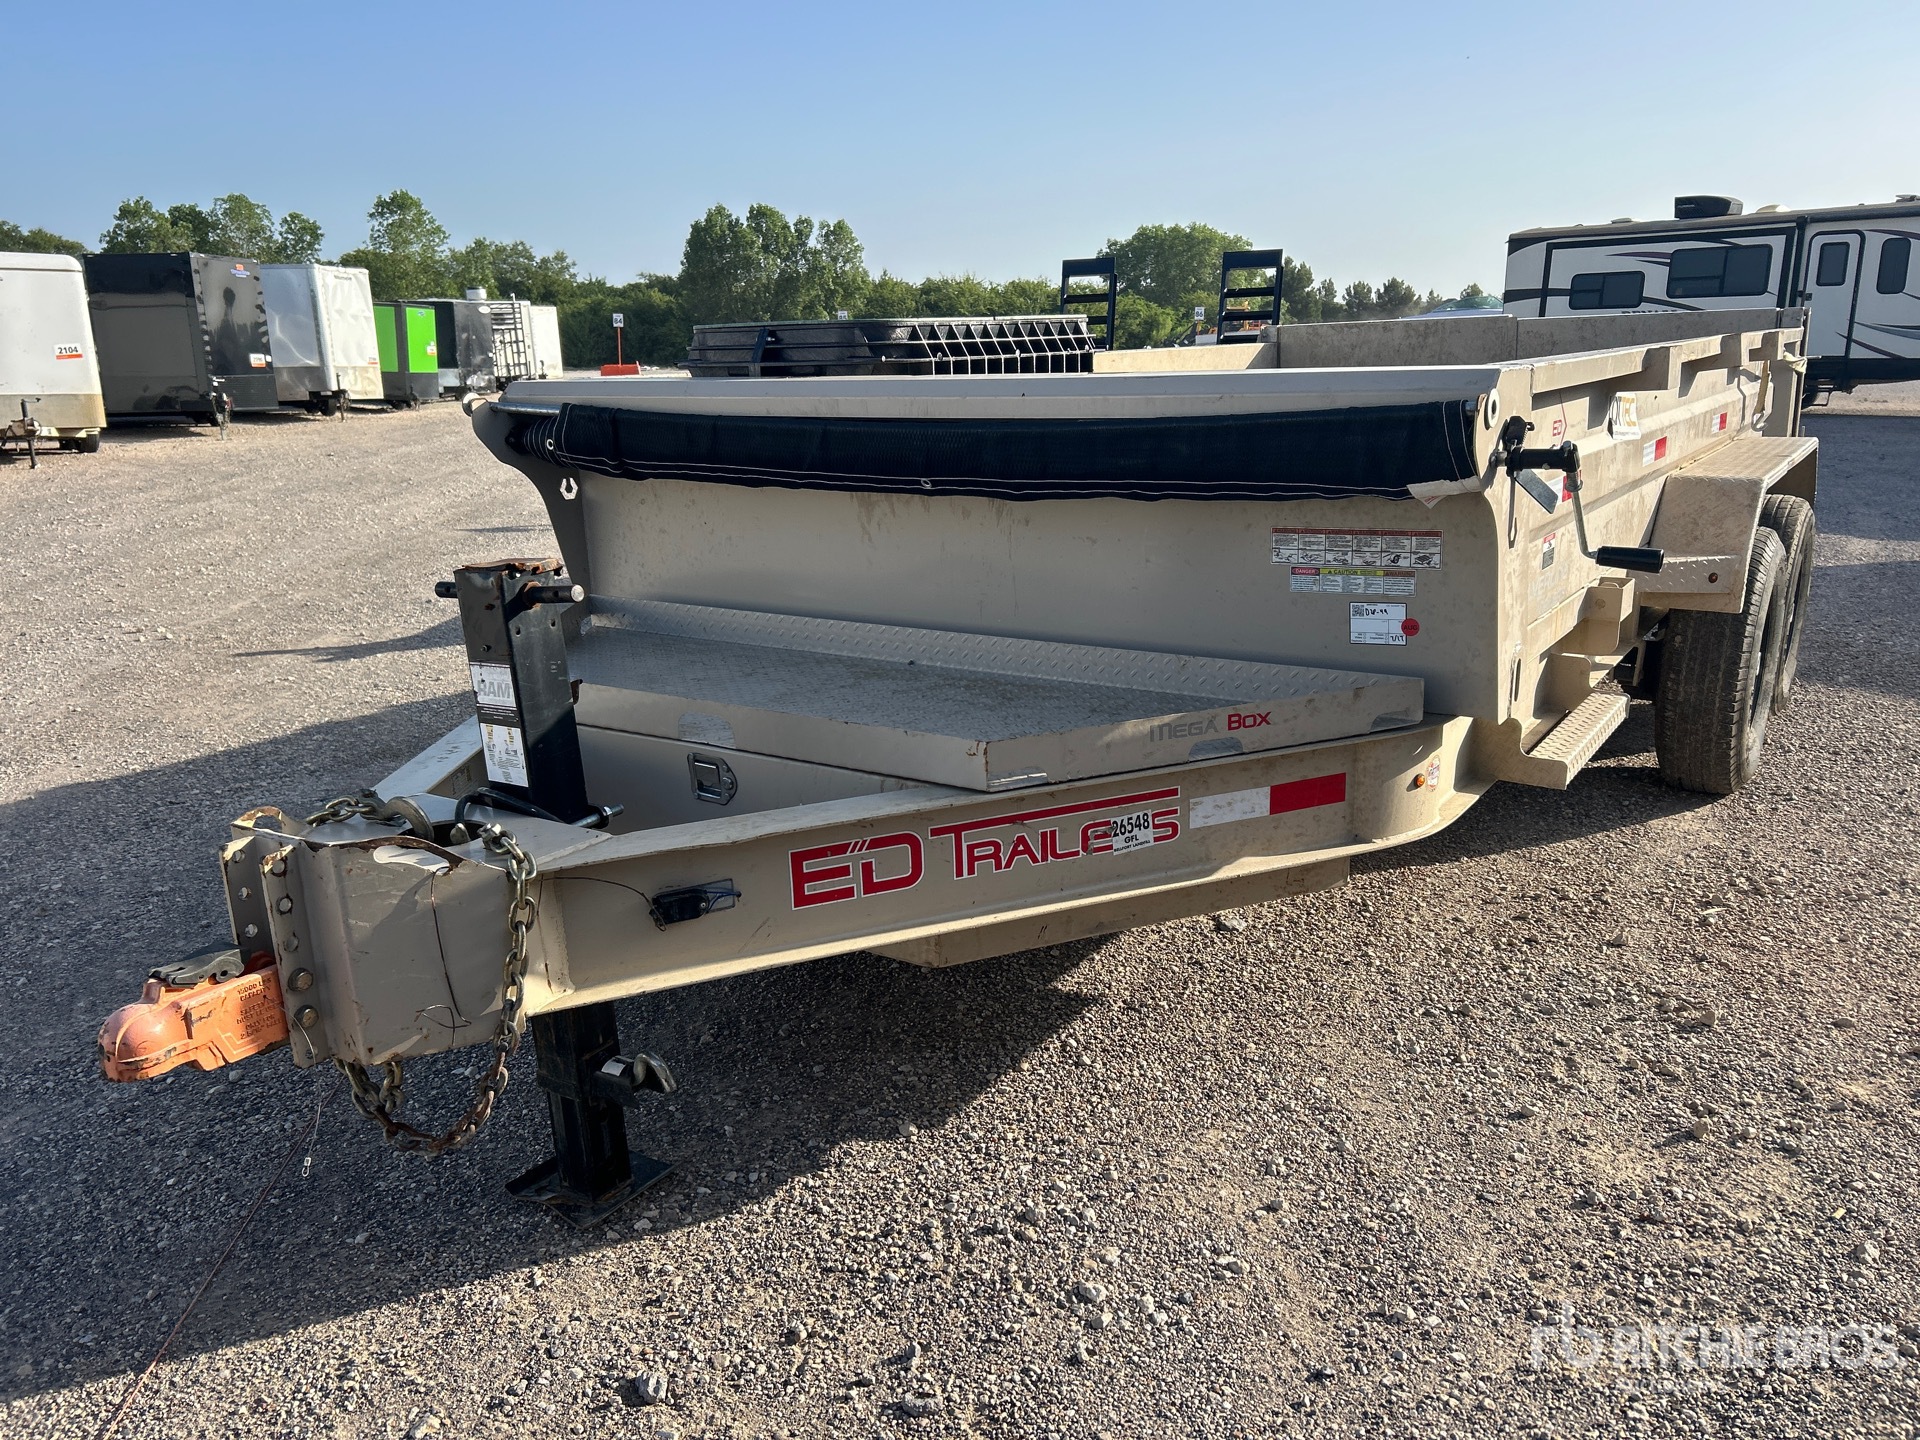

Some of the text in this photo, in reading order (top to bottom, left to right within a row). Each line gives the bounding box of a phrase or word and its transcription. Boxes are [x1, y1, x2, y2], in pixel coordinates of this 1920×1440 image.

[57, 346, 79, 355] 2104
[477, 679, 511, 699] RAM
[1112, 812, 1150, 838] 26548
[788, 785, 1181, 911] ED TRAILES
[1124, 834, 1140, 844] GFL
